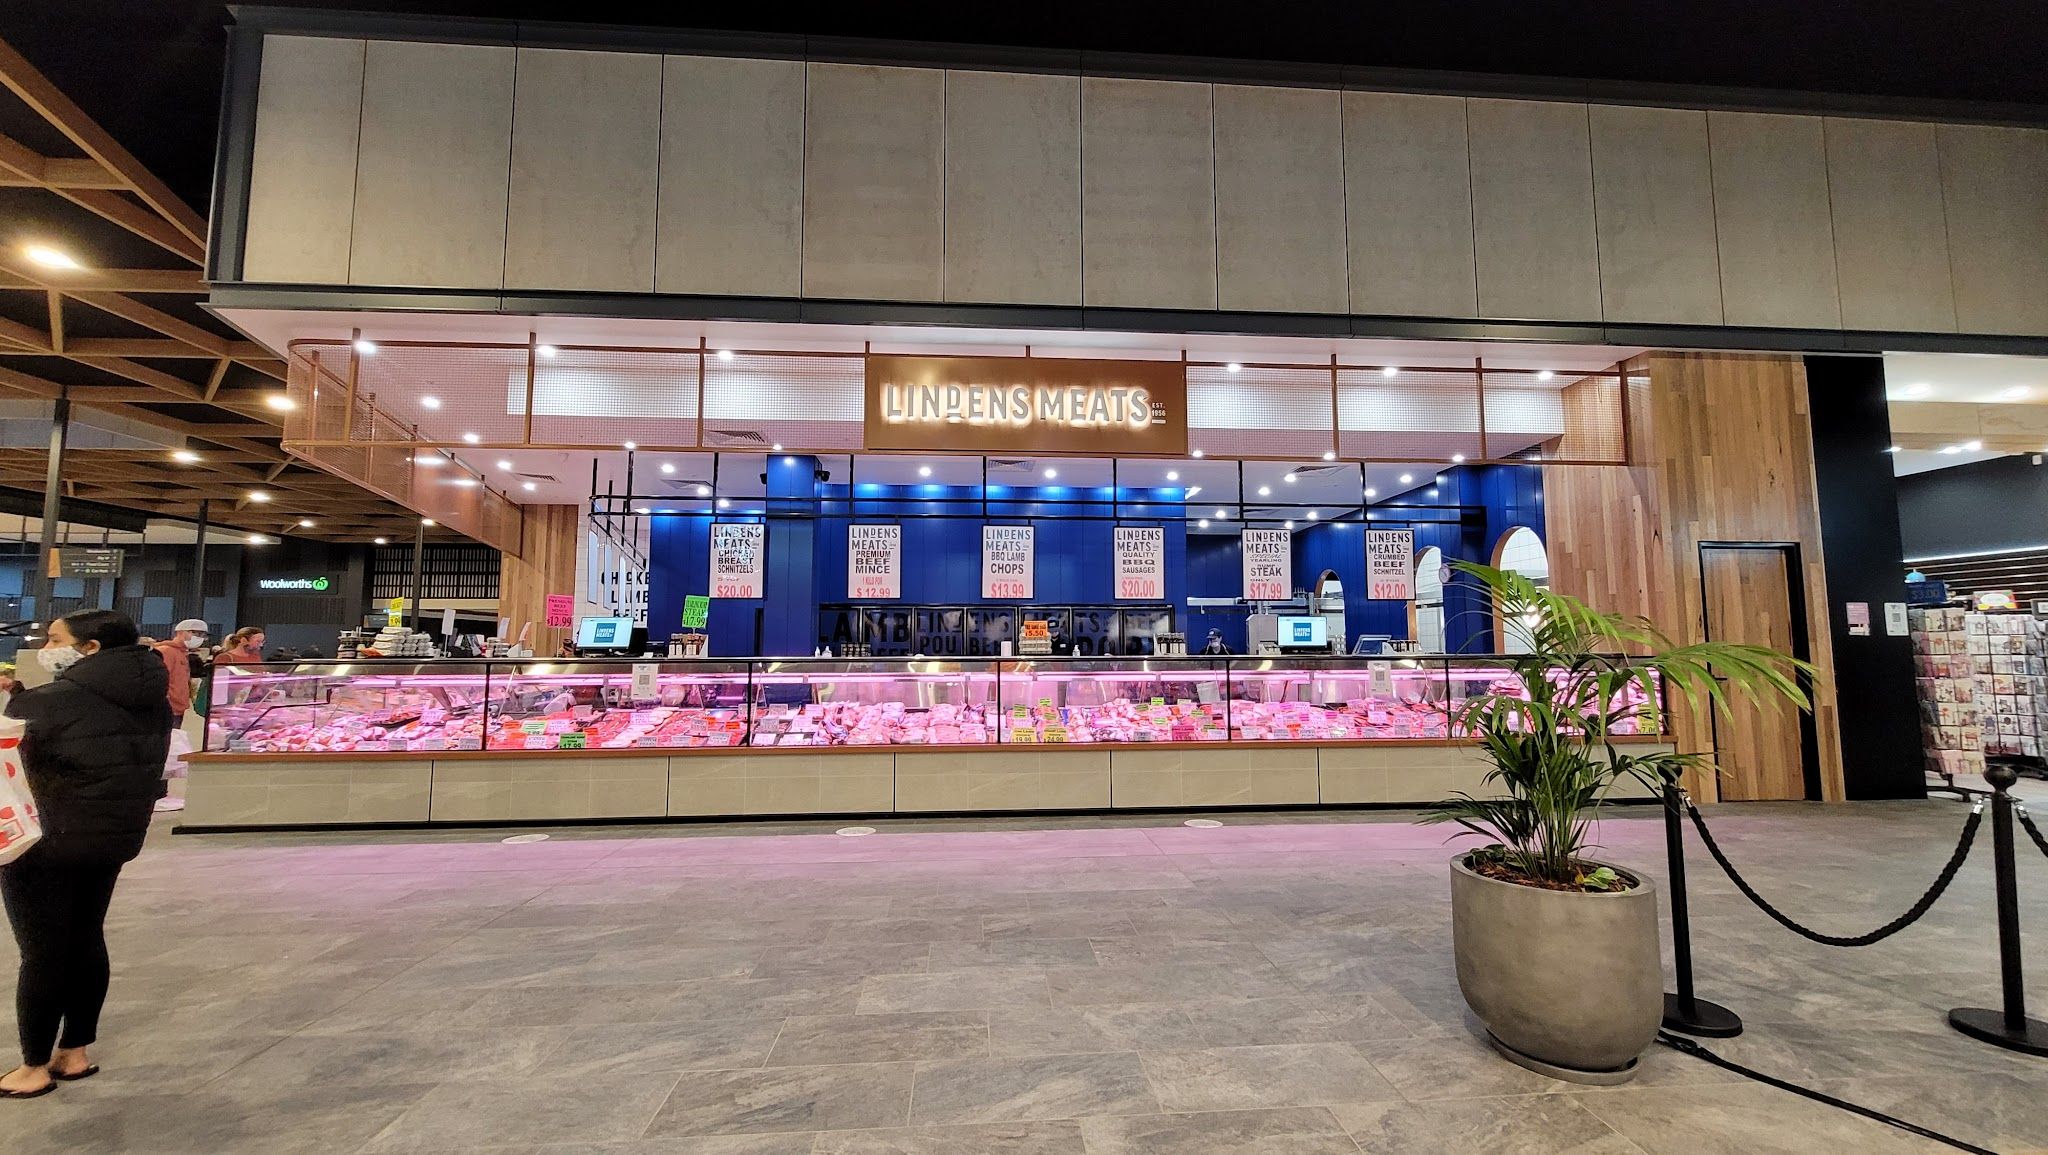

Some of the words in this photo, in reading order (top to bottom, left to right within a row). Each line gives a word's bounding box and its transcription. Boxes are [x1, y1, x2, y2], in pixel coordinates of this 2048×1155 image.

[887, 384, 1030, 421] LINDENS
[1040, 387, 1149, 423] MEATS
[714, 526, 761, 538] LINDENS
[852, 528, 898, 539] LINDENS
[985, 529, 1031, 540] LINDENS
[1117, 530, 1161, 541] LINDENS
[1245, 532, 1288, 543] LINDENS
[1368, 532, 1410, 543] LINDENS
[714, 538, 751, 550] MEATS
[851, 539, 888, 550] MEATS
[985, 540, 1021, 551] MEATS
[1117, 541, 1151, 552] MEATS
[1246, 543, 1280, 554] MEATS
[1368, 543, 1402, 554] MEATS
[856, 550, 892, 558] PREMIUM
[991, 551, 1005, 562] BBQ
[1006, 551, 1025, 562] LAMB
[718, 557, 754, 565] BREAST
[856, 557, 891, 565] BEEF
[1373, 560, 1406, 568] BEEF
[717, 564, 754, 574] SCHNITZELS
[855, 565, 891, 574] MINCE
[990, 563, 1024, 575] CHOPS
[1122, 566, 1155, 574] SAUSAGES
[1250, 567, 1282, 577] STEAK
[1373, 568, 1406, 576] SCHNITZEL
[260, 579, 313, 589] Woolworths
[1121, 580, 1155, 598] $20.00
[717, 585, 753, 598] $20.00
[865, 588, 891, 598] 12.99
[991, 583, 1024, 598] $13.99
[1250, 582, 1282, 599] $17.99
[1374, 583, 1406, 599] $12.00
[547, 616, 572, 628] $12.99
